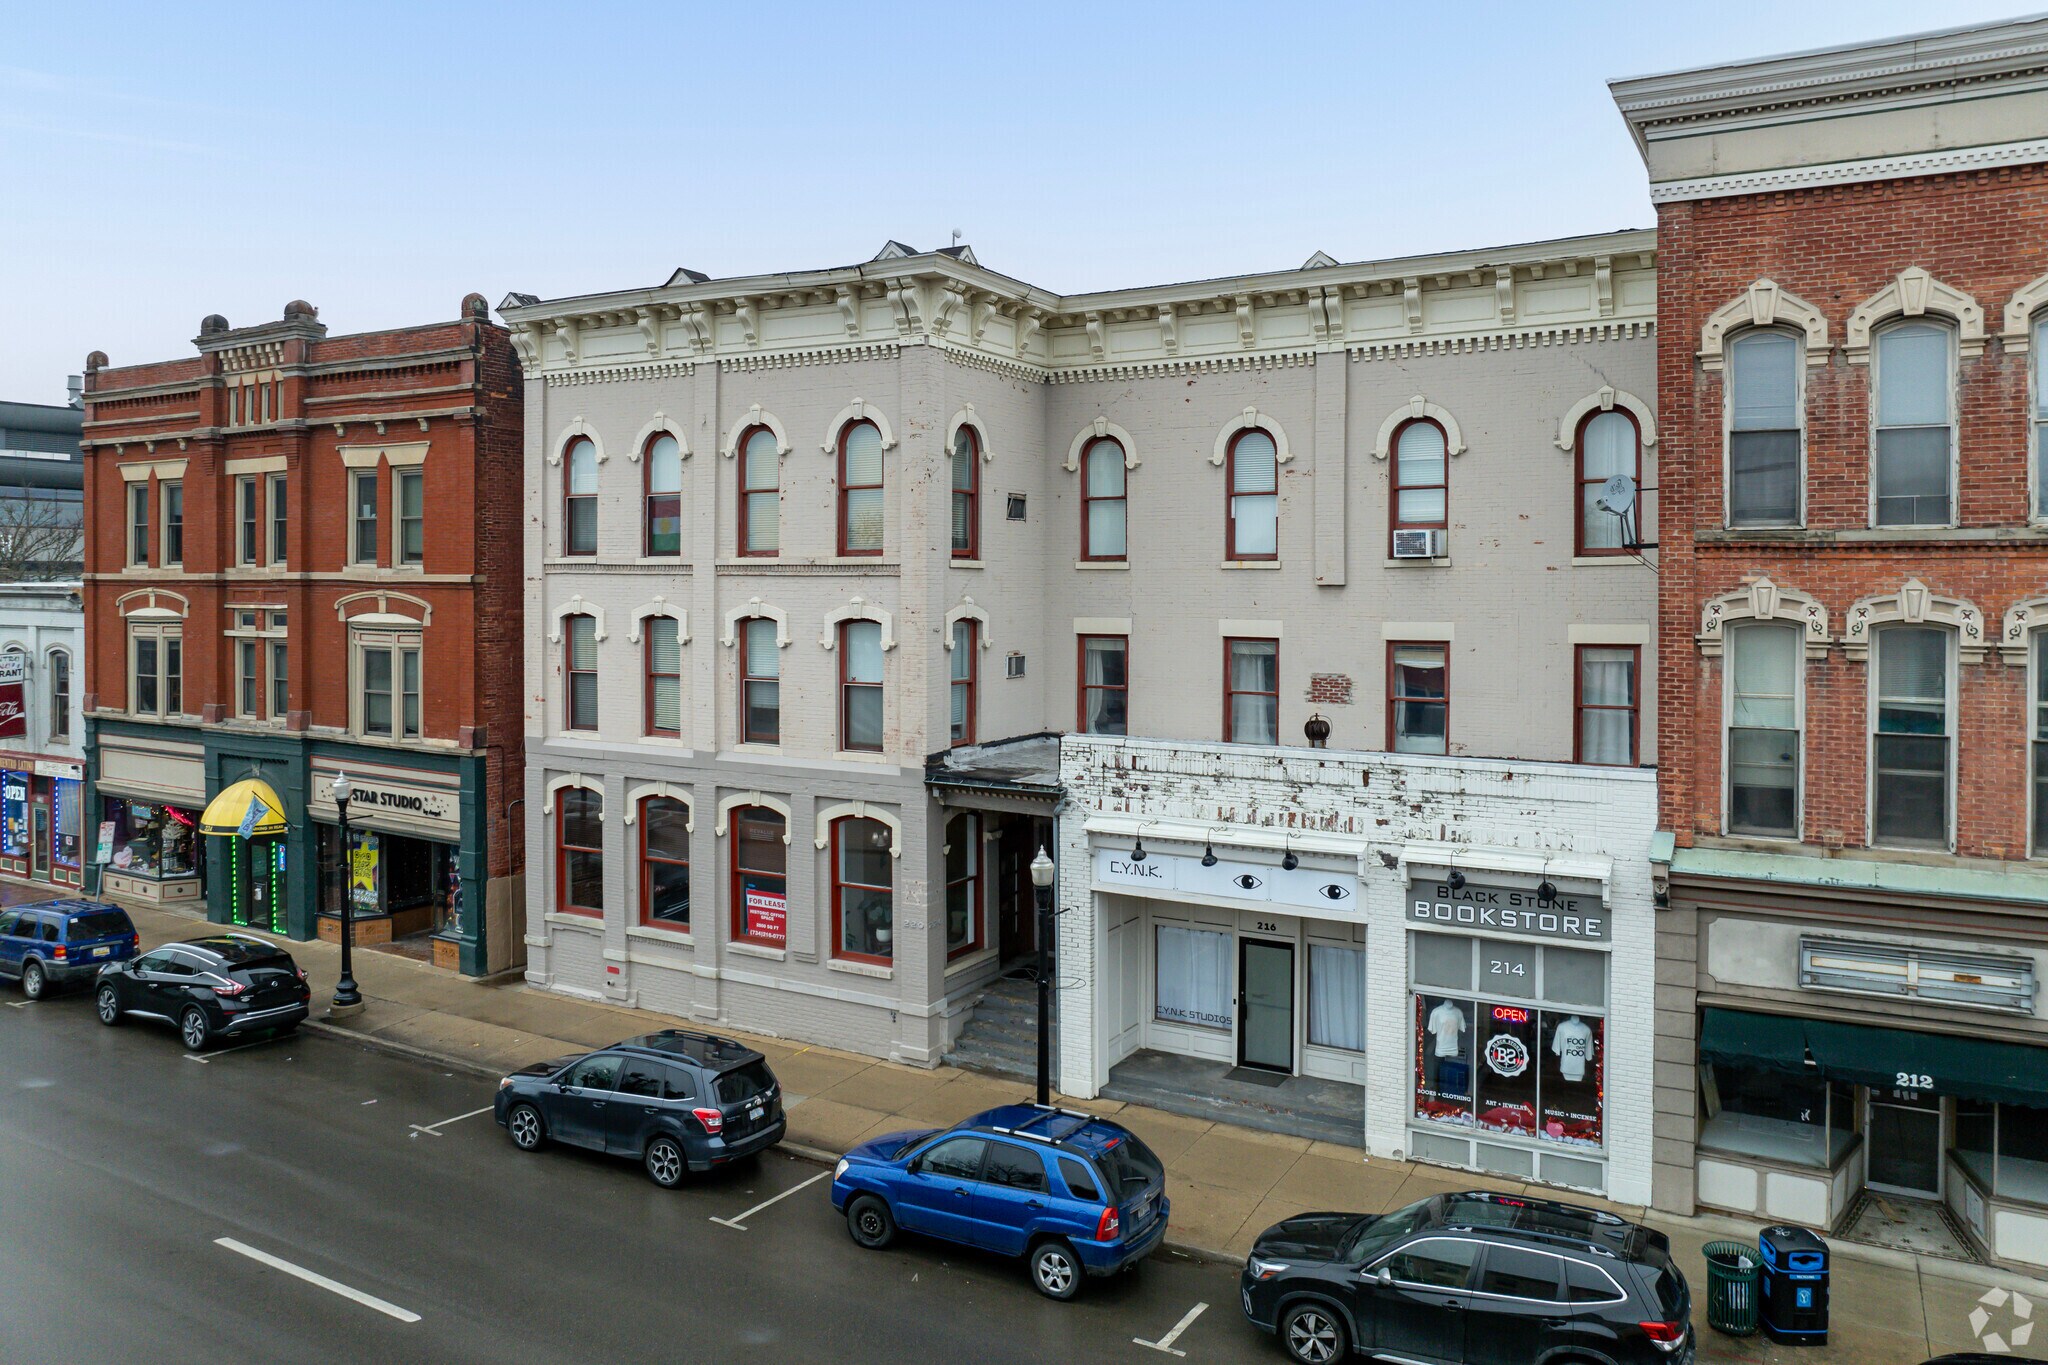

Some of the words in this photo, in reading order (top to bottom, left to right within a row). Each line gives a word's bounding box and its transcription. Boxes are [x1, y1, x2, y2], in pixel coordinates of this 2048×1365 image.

[5, 785, 26, 800] OPEN
[352, 788, 378, 804] STAR
[380, 792, 422, 811] STUDIO
[749, 897, 762, 905] FOR
[764, 899, 786, 909] LEASE
[1437, 885, 1500, 905] BLACK
[1509, 893, 1579, 912] STONE
[1257, 921, 1276, 931] 216
[1414, 901, 1602, 937] BOOKSTORE
[1490, 960, 1526, 977] 214
[1189, 1010, 1232, 1025] STUDIOS
[1494, 1007, 1528, 1022] OPEN
[1896, 1072, 1934, 1089] 212
[1417, 1088, 1437, 1097] BOOKS
[1442, 1092, 1472, 1103] CLOTHING
[1485, 1099, 1497, 1107] ART
[1544, 1108, 1565, 1117] MUSIC
[1570, 1112, 1597, 1122] INCENSE
